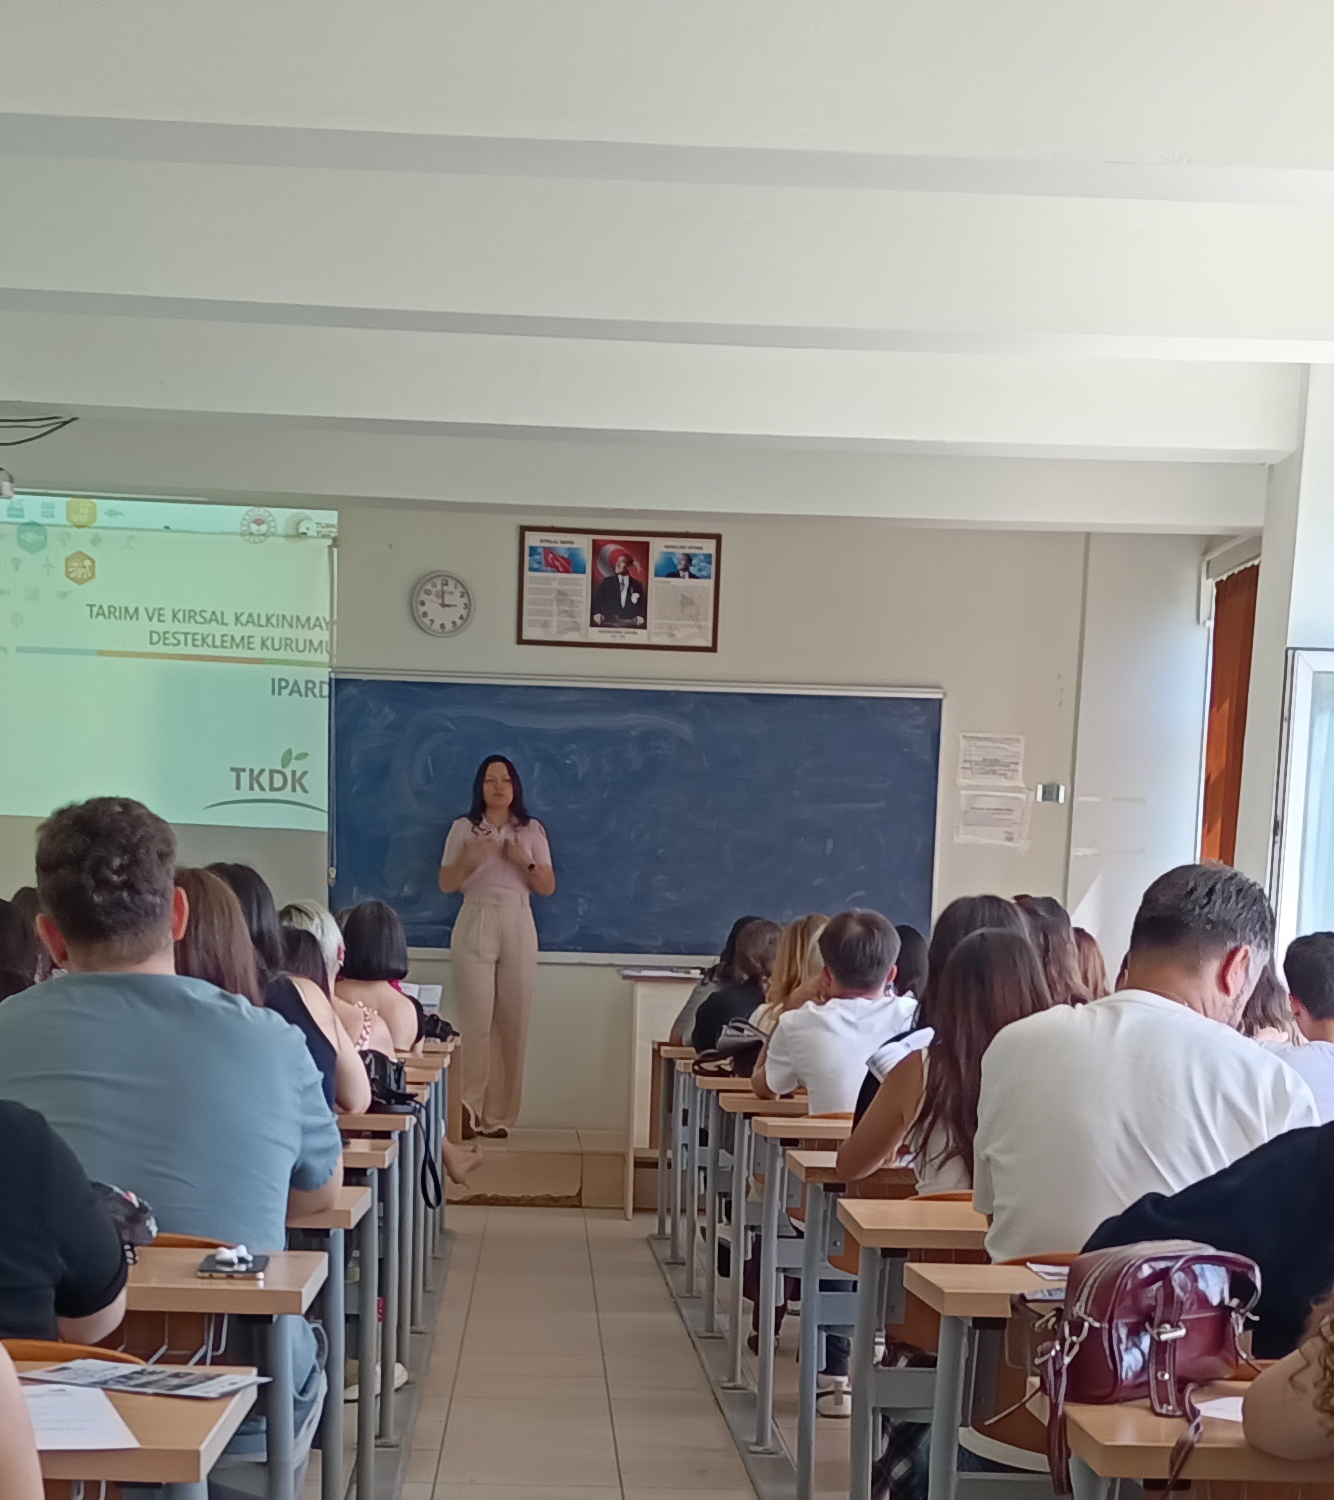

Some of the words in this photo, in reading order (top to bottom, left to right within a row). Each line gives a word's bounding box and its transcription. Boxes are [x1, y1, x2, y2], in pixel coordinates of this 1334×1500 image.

[86, 604, 139, 622] TARIM
[144, 606, 166, 623] VE
[171, 608, 229, 626] KIRSAL
[149, 630, 256, 651] DESTEKLEME
[230, 767, 309, 794] TKDK
